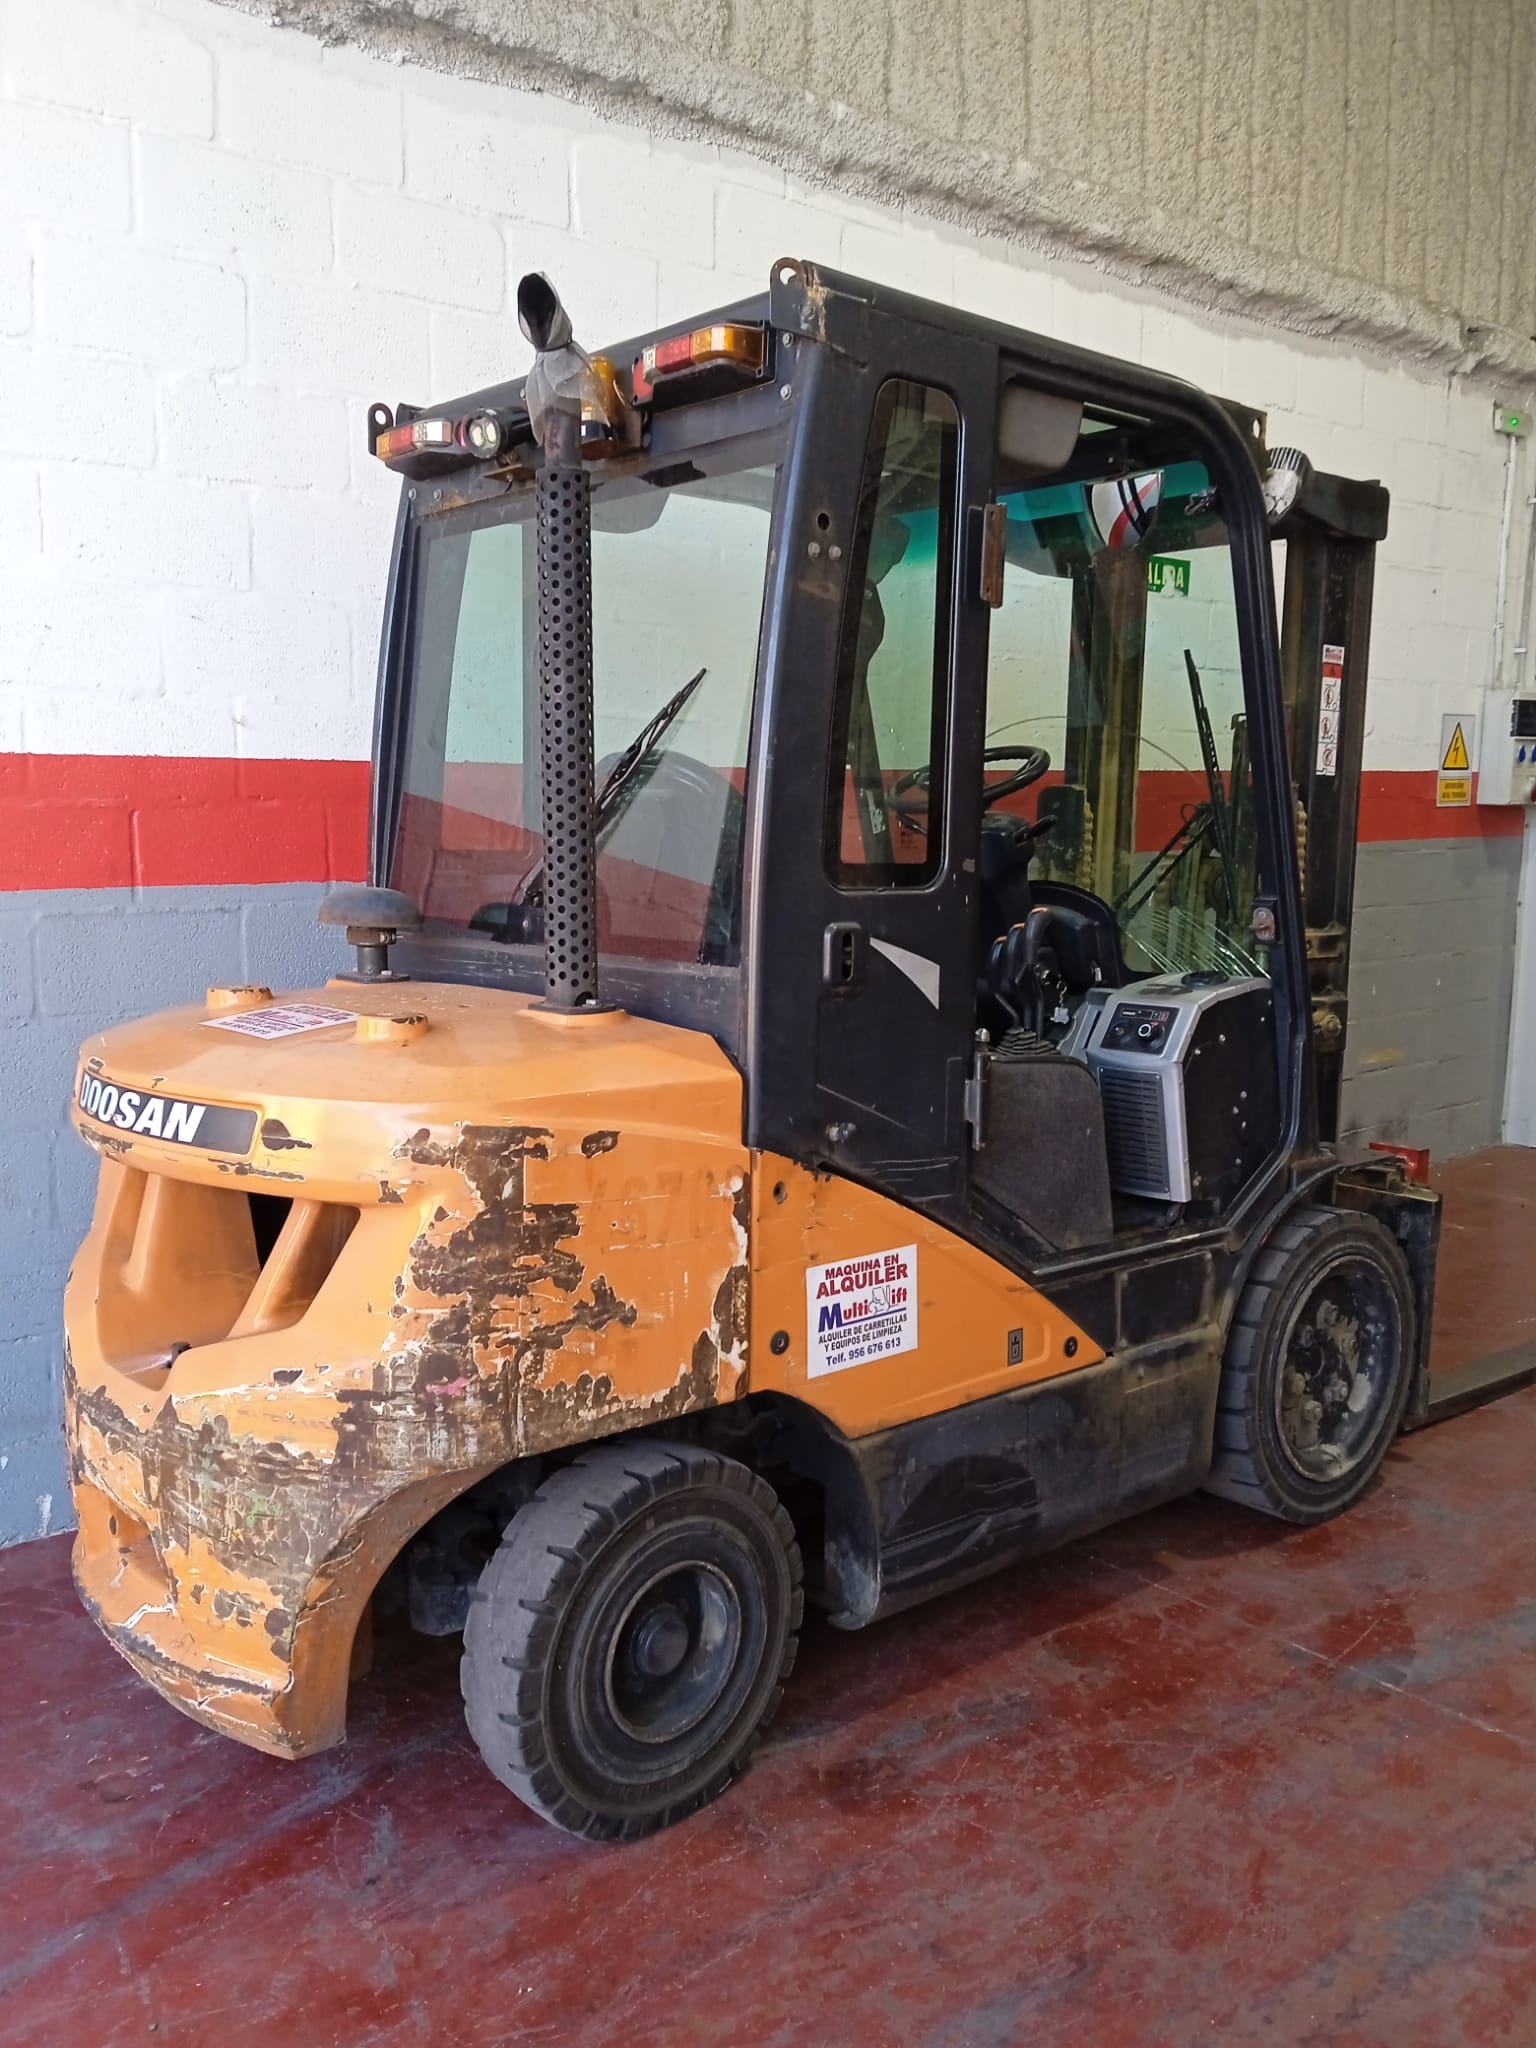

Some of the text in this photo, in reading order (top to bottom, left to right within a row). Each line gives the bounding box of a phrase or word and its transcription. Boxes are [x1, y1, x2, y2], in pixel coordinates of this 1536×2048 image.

[80, 1072, 207, 1143] DOOSAN
[816, 1263, 908, 1299] ALQUILER
[825, 1253, 899, 1280] MAQUINA EN
[818, 1313, 908, 1345] ALQUILER DE CARRETILLAS
[824, 1324, 902, 1352] Y EQUIPOS DE LIMPIEZA
[826, 1337, 901, 1366] Telf. 956 676 613
